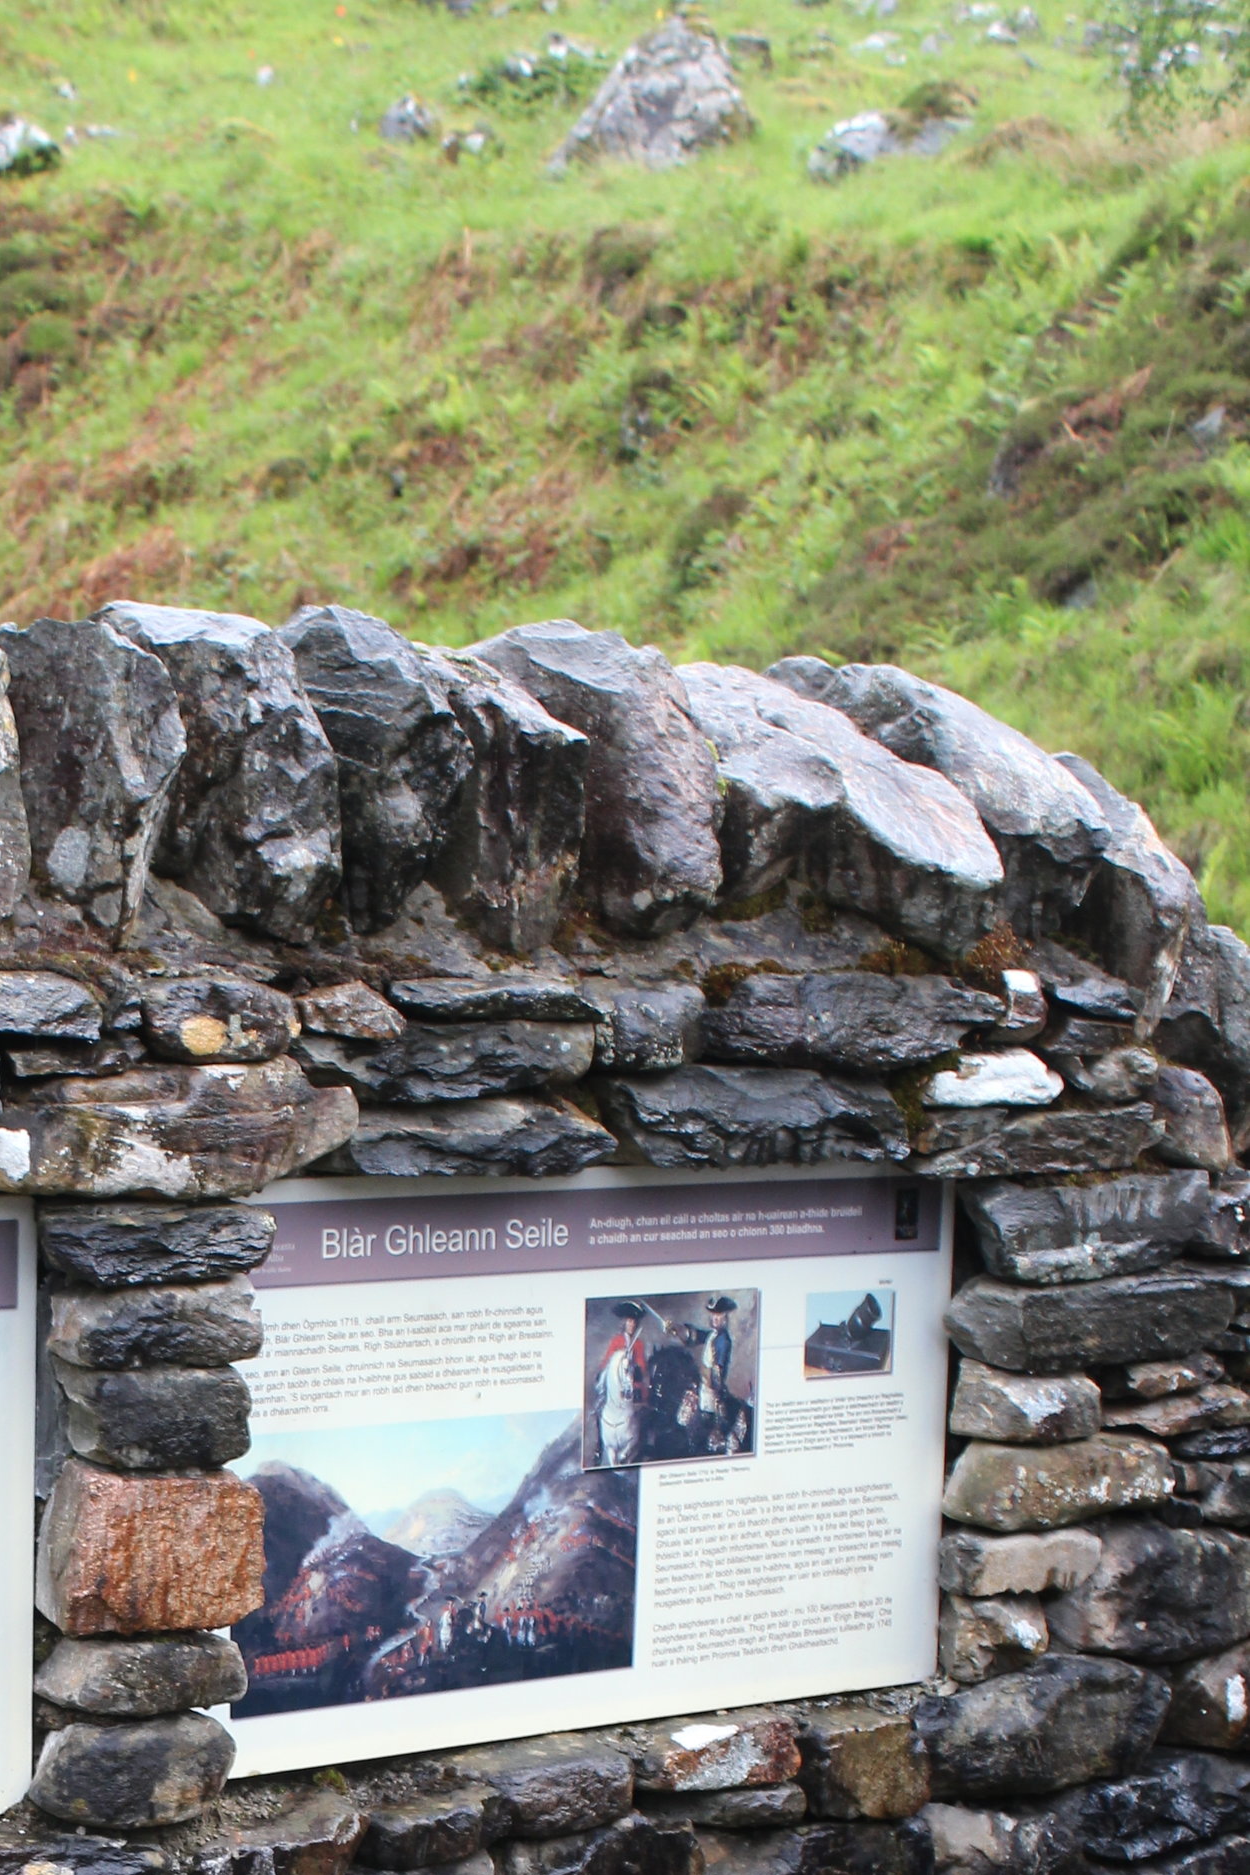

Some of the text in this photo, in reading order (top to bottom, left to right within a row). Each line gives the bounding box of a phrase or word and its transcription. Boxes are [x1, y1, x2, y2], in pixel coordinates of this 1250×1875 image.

[320, 1226, 376, 1258] Blàr
[384, 1220, 496, 1255] Ghleann
[504, 1216, 568, 1249] Seile
